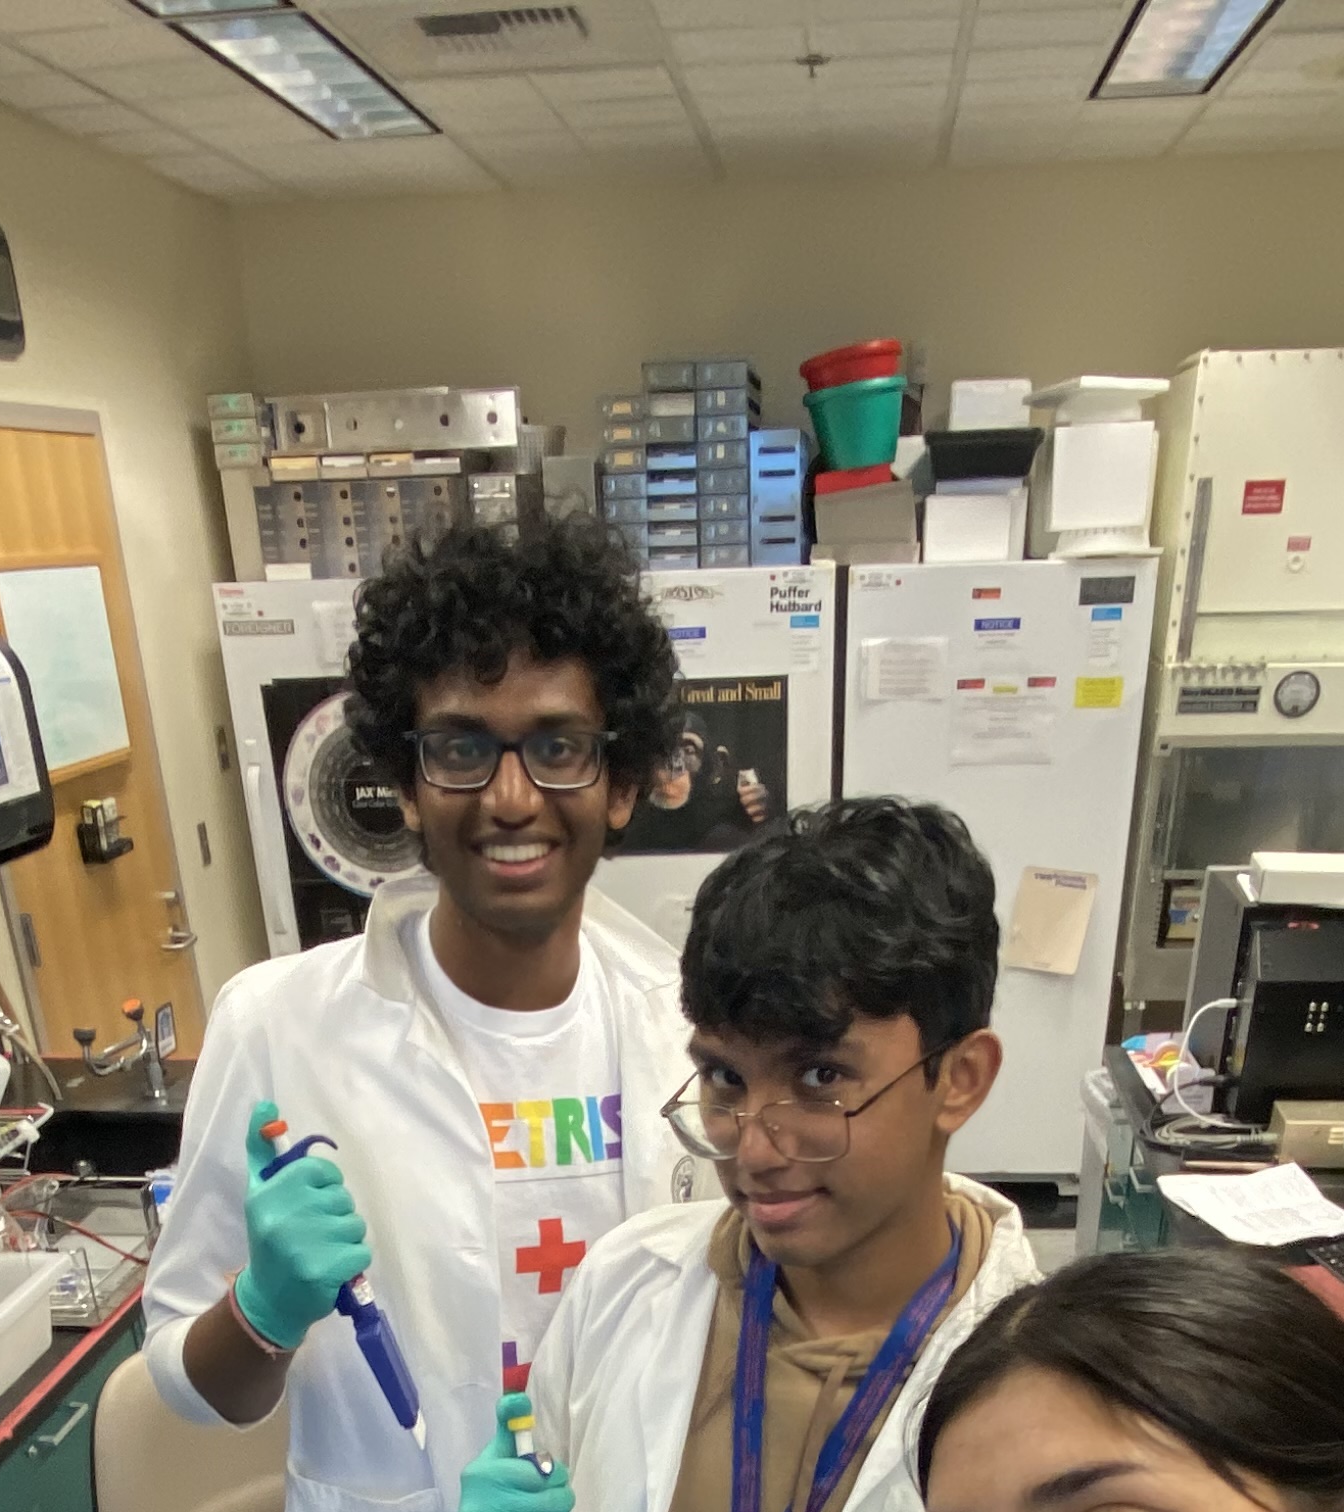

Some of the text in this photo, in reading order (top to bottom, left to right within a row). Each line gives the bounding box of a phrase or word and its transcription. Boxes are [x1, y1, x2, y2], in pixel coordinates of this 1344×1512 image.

[769, 586, 811, 600] Puffer
[769, 600, 823, 614] Hubbard
[981, 618, 1016, 630] NOTICE
[717, 682, 743, 702] and
[744, 680, 782, 701] Small
[479, 1094, 622, 1170] ETRIS
